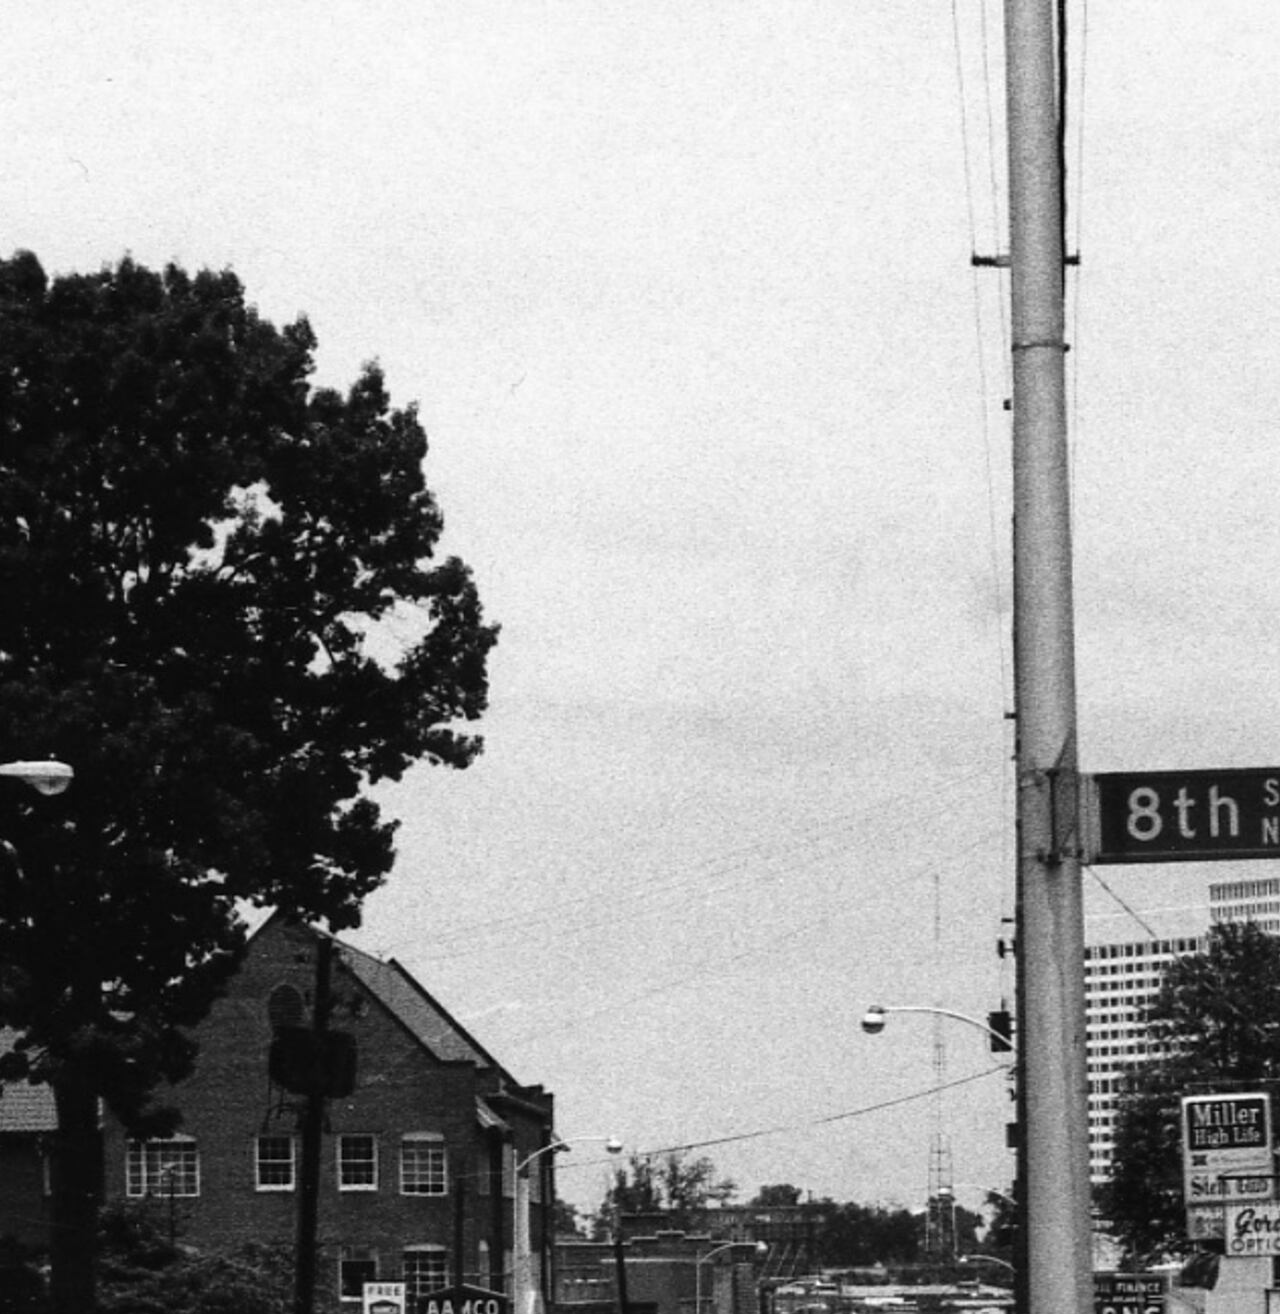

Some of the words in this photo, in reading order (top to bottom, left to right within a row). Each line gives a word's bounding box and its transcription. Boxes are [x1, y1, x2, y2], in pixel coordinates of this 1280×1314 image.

[1127, 785, 1239, 841] 8th
[1192, 1103, 1261, 1127] Miller
[1194, 1128, 1229, 1146] High
[1233, 1127, 1261, 1142] Life
